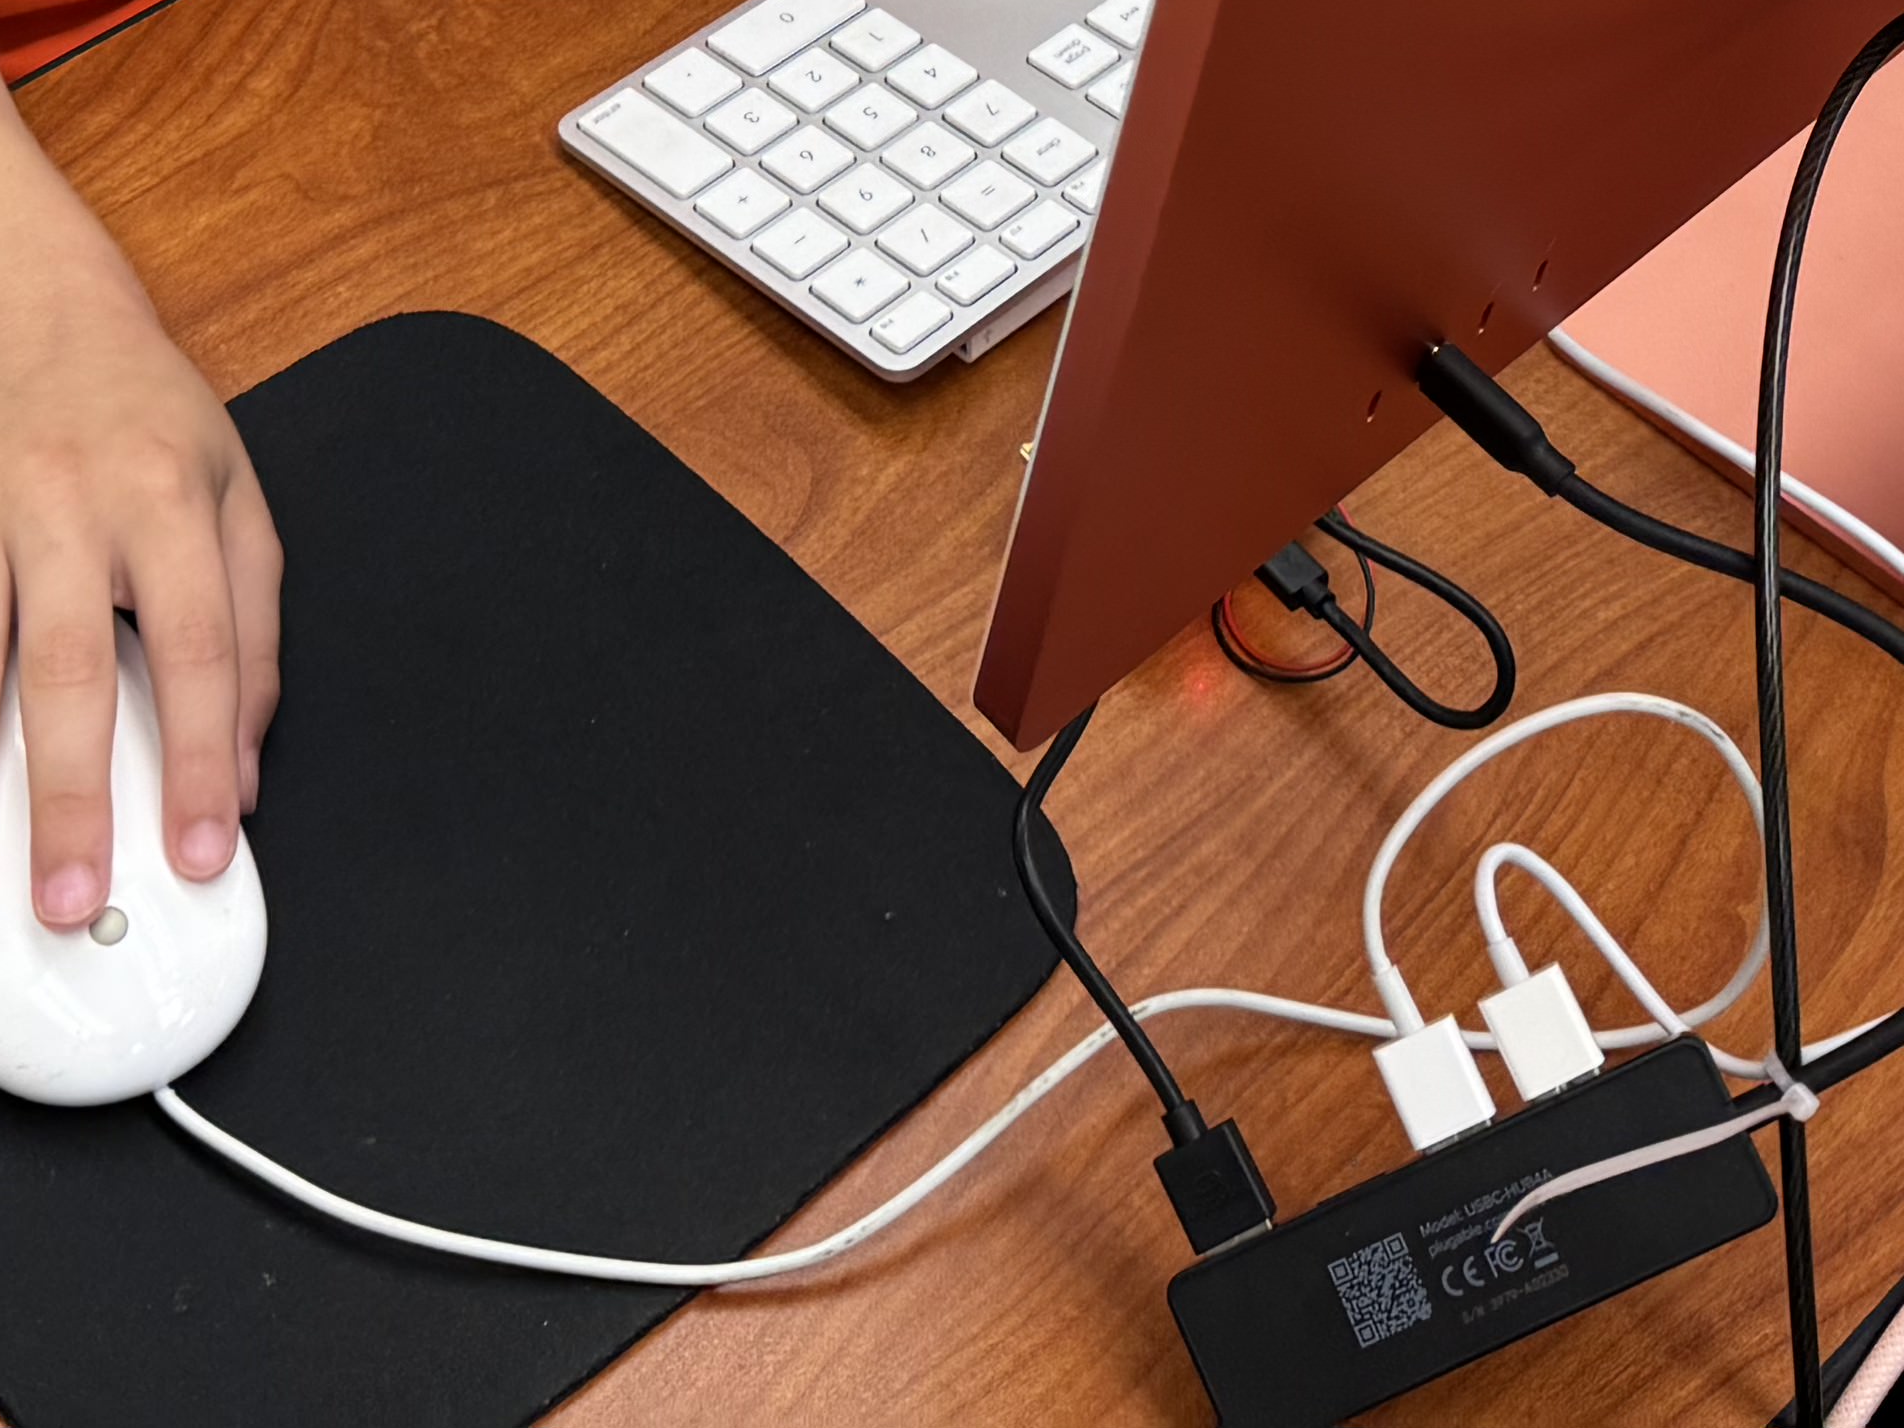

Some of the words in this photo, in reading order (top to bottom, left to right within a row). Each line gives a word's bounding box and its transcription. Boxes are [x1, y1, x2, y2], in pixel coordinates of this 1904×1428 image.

[779, 12, 795, 24] 0
[868, 32, 883, 42] 1
[805, 70, 822, 83] 2
[923, 67, 937, 78] 4
[862, 106, 879, 120] 5
[985, 102, 1000, 116] 7
[743, 111, 760, 124] 3
[799, 150, 814, 162] 6
[920, 145, 936, 158] 8
[858, 188, 873, 202] 9
